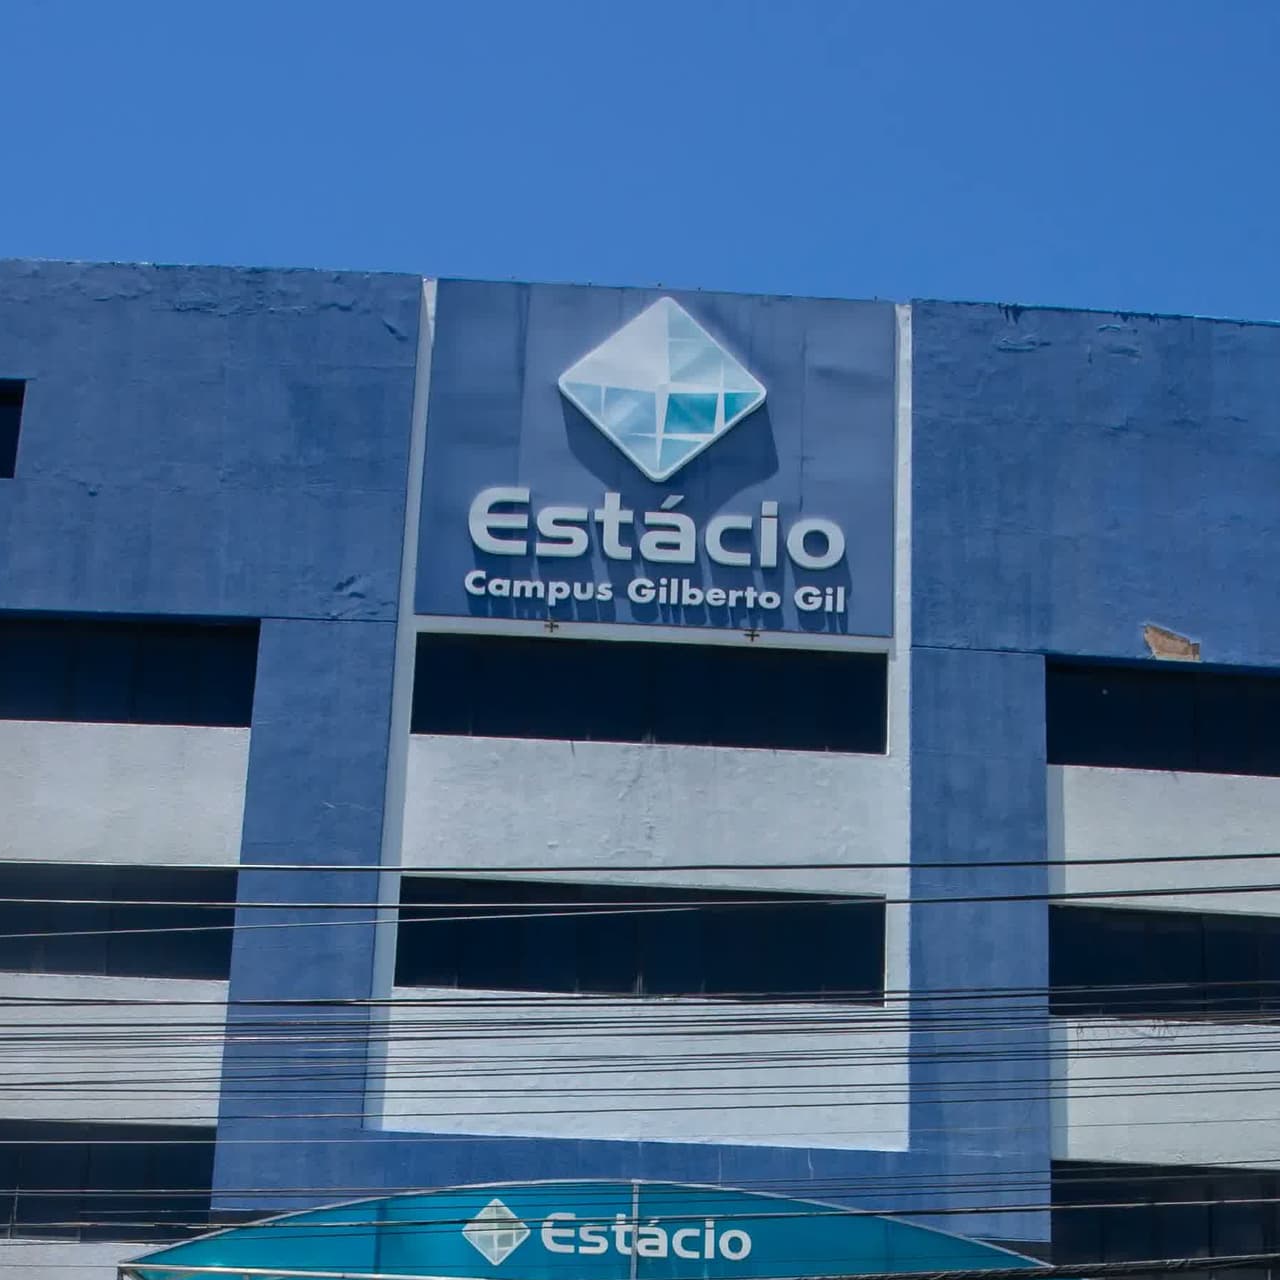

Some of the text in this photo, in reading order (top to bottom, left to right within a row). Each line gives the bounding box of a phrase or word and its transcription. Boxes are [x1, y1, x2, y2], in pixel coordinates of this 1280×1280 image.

[468, 487, 846, 570] Estácio
[464, 570, 845, 613] Campus Gilberto Gil
[541, 1212, 752, 1260] Estácio
